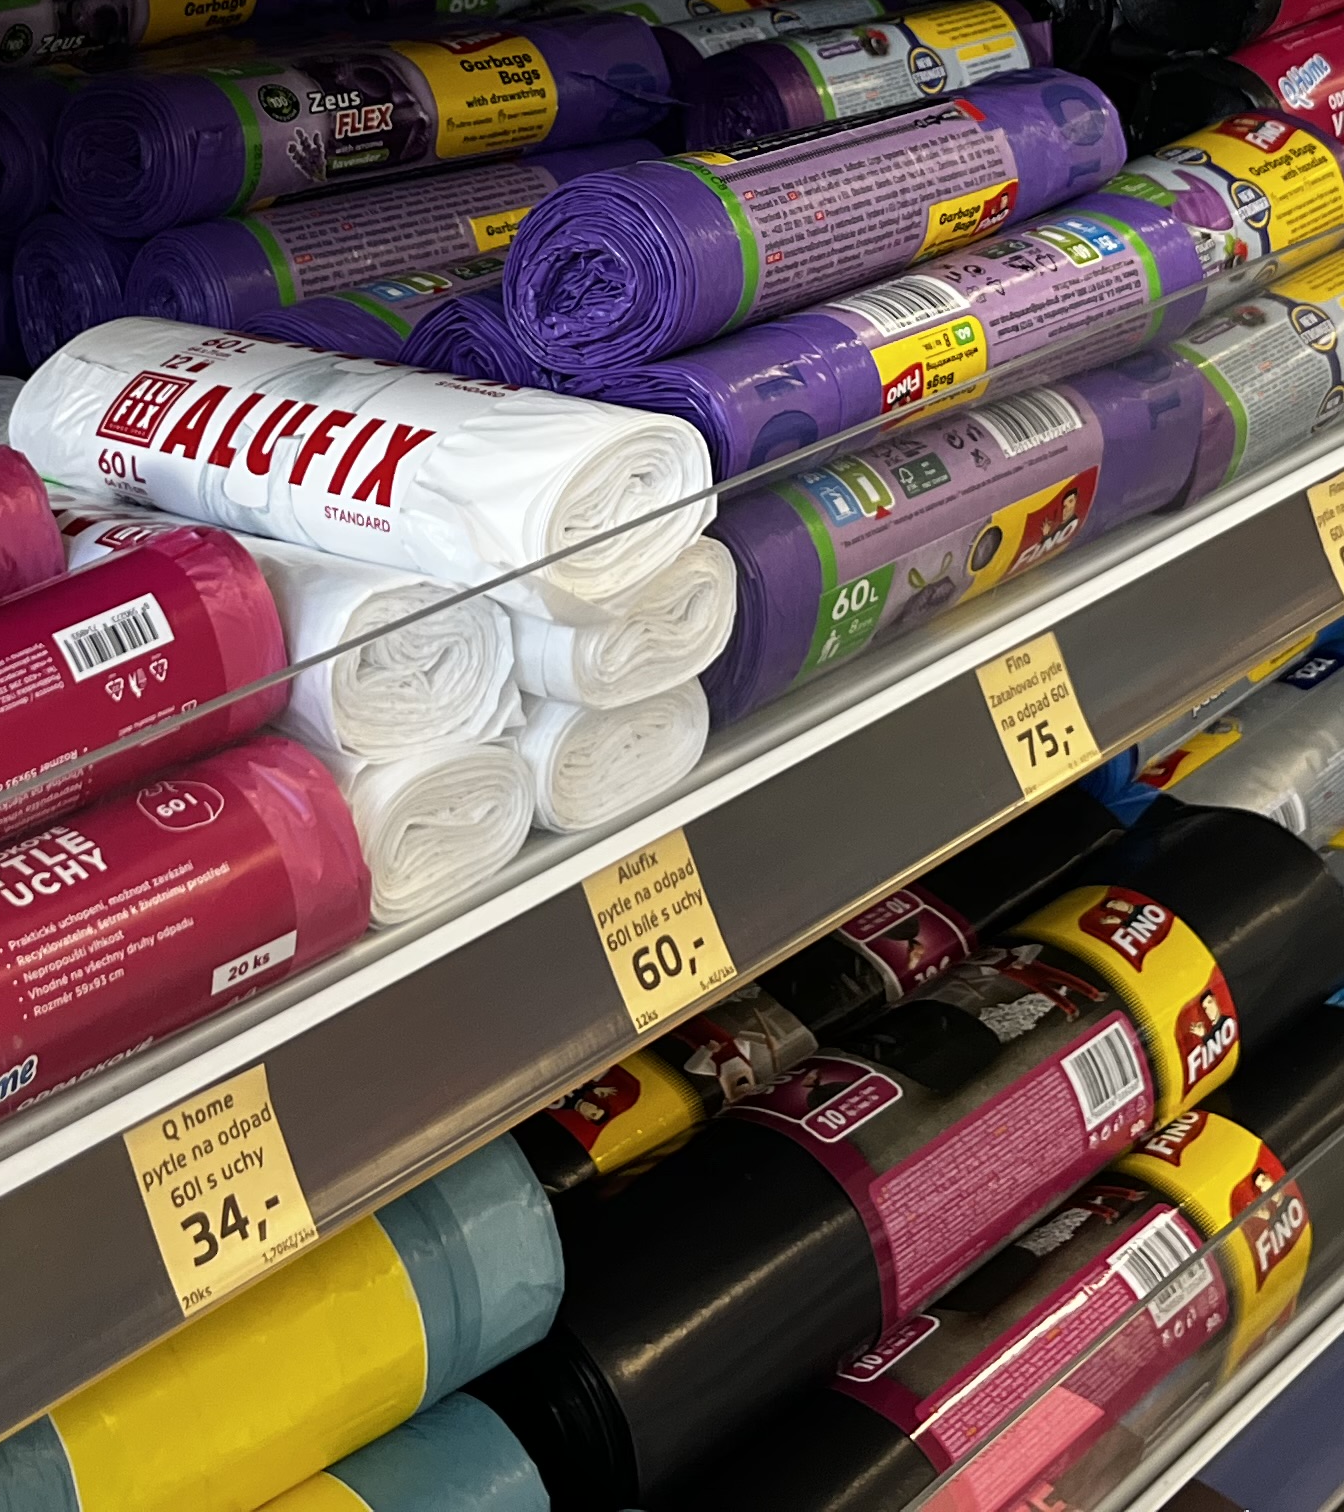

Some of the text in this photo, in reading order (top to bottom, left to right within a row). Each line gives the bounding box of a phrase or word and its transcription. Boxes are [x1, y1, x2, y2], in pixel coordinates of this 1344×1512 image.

[459, 50, 533, 76] Garbage
[497, 67, 542, 89] Bags
[309, 90, 361, 116] Zeus
[335, 103, 394, 140] FLEX
[98, 449, 126, 478] 60
[160, 385, 437, 508] ALUFIX
[324, 506, 390, 533] STANDARD
[1006, 653, 1031, 674] Fino
[1001, 715, 1015, 731] na
[1017, 692, 1050, 722] odpad
[1017, 720, 1074, 767] 75,-
[0, 849, 108, 909] UCHY
[617, 851, 658, 884] Alufix
[597, 858, 694, 929] pytle na odpad
[632, 910, 659, 937] bílé
[661, 907, 670, 922] s
[672, 888, 703, 916] uchy
[1111, 903, 1166, 957] FINO
[228, 950, 270, 982] 20 ks
[632, 934, 704, 991] 60,-
[1186, 1017, 1238, 1085] FINO
[162, 1093, 234, 1141] Q home
[142, 1102, 272, 1192] pytle na odpad
[171, 1146, 264, 1208] 60l s uchy
[181, 1193, 280, 1267] 34,-
[1254, 1198, 1304, 1272] FINO
